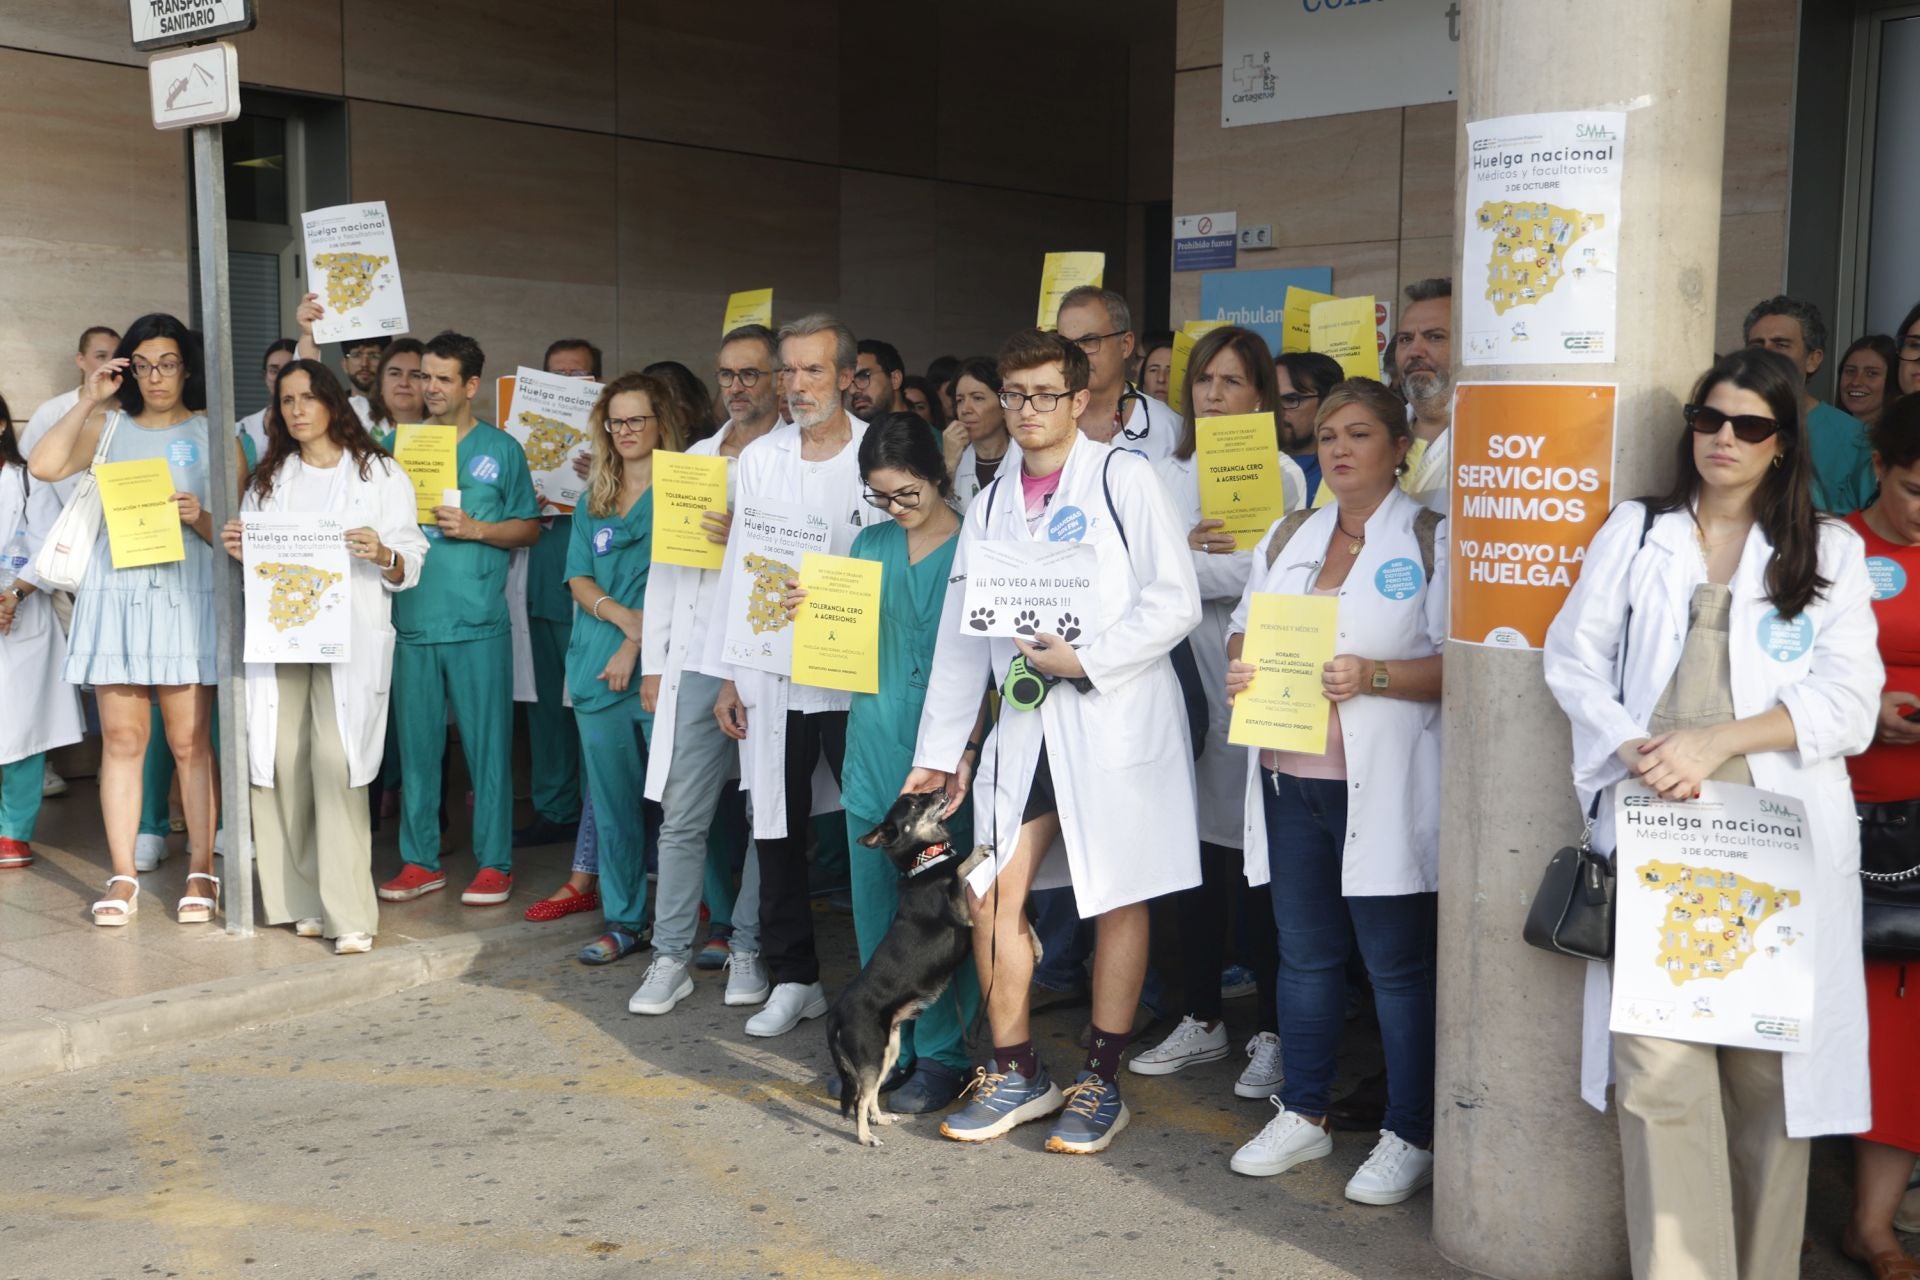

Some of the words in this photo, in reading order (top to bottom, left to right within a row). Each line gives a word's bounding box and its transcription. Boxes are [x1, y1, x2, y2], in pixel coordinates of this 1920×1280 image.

[160, 8, 215, 33] SANITARIO
[1473, 151, 1524, 170] Huelga
[1530, 145, 1614, 163] nacional
[1477, 169, 1518, 181] Médicos
[1521, 170, 1528, 179] y
[1532, 164, 1609, 177] facultativos
[1522, 181, 1560, 191] OCTUBRE
[341, 219, 385, 232] nacional
[1177, 239, 1210, 250] Prohibido
[1211, 239, 1233, 248] fumar
[519, 384, 555, 400] Huelga
[1487, 434, 1547, 460] SOY
[1209, 465, 1245, 473] TOLERANCIA
[1246, 463, 1264, 471] CERO
[1221, 473, 1259, 482] AGRESIONES
[1457, 464, 1600, 493] SERVICIOS
[665, 492, 697, 501] TOLERANCIA
[676, 502, 707, 510] AGRESIONES
[1463, 489, 1587, 523] MÍNIMOS
[744, 517, 776, 535] Huelga
[780, 527, 827, 543] nacional
[247, 532, 288, 544] Huelga
[292, 532, 342, 542] nacional
[1459, 540, 1479, 558] YO
[1481, 542, 1554, 562] APOYO
[1559, 546, 1587, 564] LA
[1469, 560, 1571, 587] HUELGA
[990, 577, 1006, 587] NO
[1008, 577, 1028, 587] VEO
[1030, 578, 1037, 587] A
[1039, 578, 1052, 587] MI
[1054, 576, 1090, 588] DUEÑO
[994, 596, 1008, 606] EN
[1010, 597, 1022, 606] 24
[1024, 597, 1058, 607] HORAS
[1060, 597, 1071, 607] !!!
[809, 602, 845, 612] TOLERANCIA
[846, 607, 863, 615] CERO
[820, 613, 857, 624] AGRESIONES
[1245, 718, 1273, 727] ESTATUTO
[1273, 721, 1293, 729] MARCO
[1293, 723, 1313, 731] PROPIO
[1626, 811, 1702, 831] Huelga
[1711, 818, 1803, 839] nacional
[1635, 828, 1697, 843] Médicos
[1702, 834, 1710, 844] y
[1714, 832, 1800, 851] facultativos
[1681, 847, 1687, 855] 3
[1689, 847, 1701, 856] DE
[1703, 848, 1749, 860] OCTUBRE
